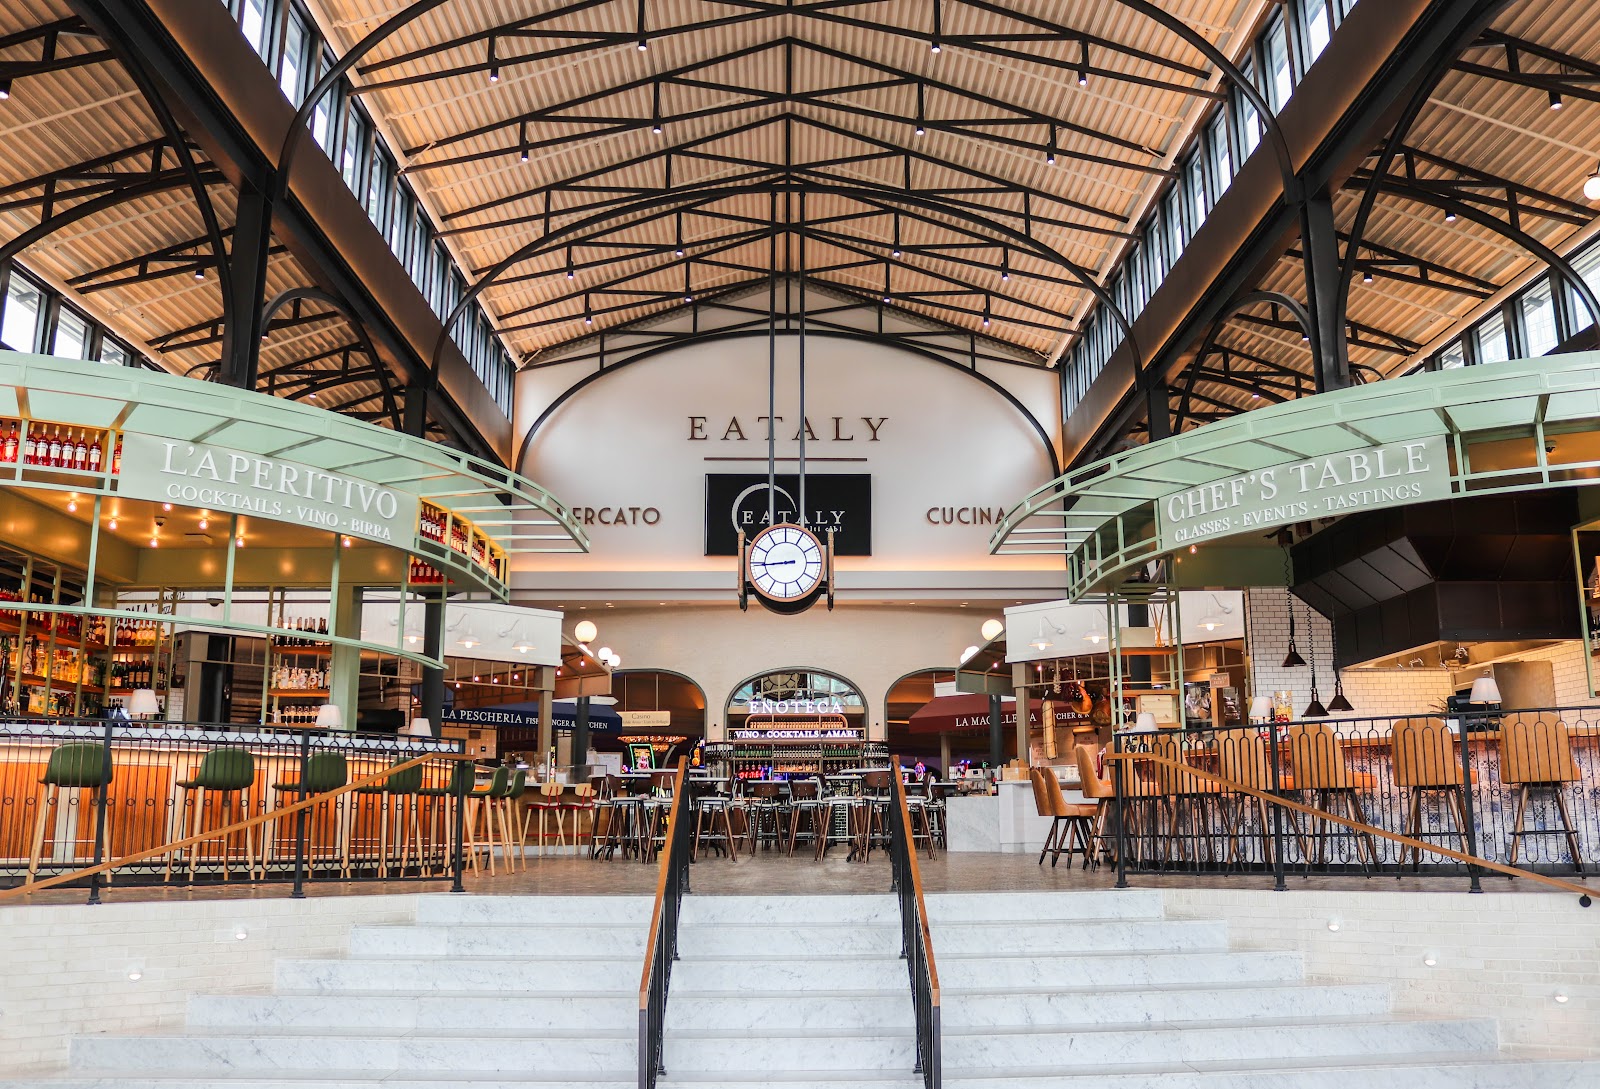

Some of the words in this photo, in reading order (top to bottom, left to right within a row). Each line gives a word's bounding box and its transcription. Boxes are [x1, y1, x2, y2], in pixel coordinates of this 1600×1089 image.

[687, 416, 889, 441] EATALY
[160, 442, 398, 519] L'APERITIVO
[1167, 470, 1278, 522] CHEF'S
[1289, 442, 1430, 493] TABLE
[167, 484, 282, 516] COCKTAILS
[297, 506, 339, 527] VINO
[351, 518, 391, 540] BIRRA
[926, 507, 1005, 524] CUCINA
[1175, 517, 1231, 543] CLASSES
[1242, 501, 1308, 527] EVENTS
[1322, 482, 1422, 512] TASTINGS
[441, 708, 457, 719] LA
[460, 710, 522, 724] PESCHERIA
[631, 712, 651, 720] Casino
[748, 701, 844, 714] ENOTECA
[955, 717, 969, 727] LA
[735, 731, 759, 739] VINO
[766, 730, 819, 739] COCKTAILS
